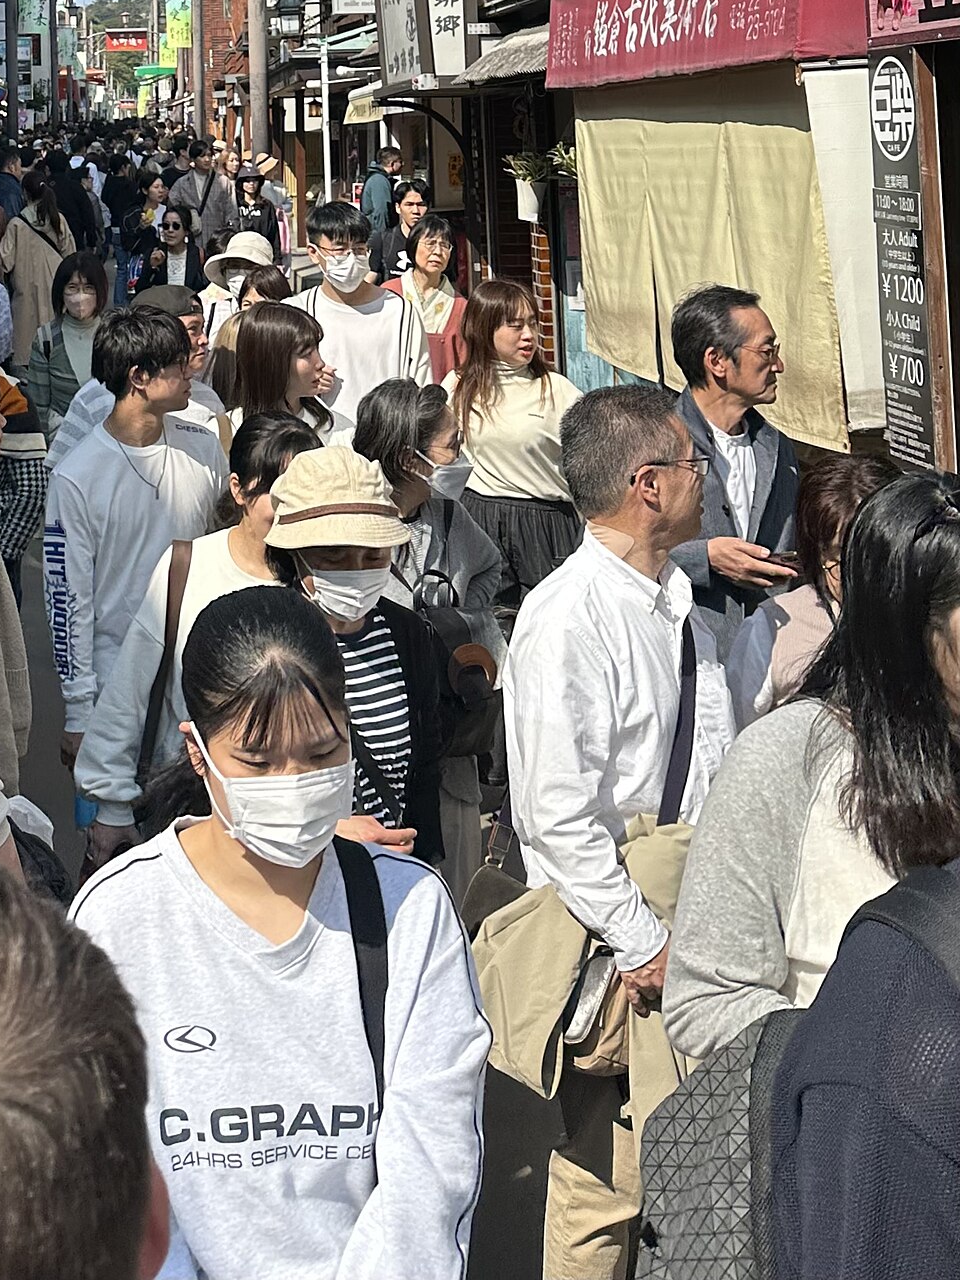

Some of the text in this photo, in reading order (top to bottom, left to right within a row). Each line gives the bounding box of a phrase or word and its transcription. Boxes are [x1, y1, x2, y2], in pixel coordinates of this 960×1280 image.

[872, 74, 912, 141] 豆柴
[887, 143, 901, 152] CAFE
[899, 231, 918, 248] Adult
[902, 312, 920, 331] Child
[888, 352, 923, 386] ¥700
[44, 541, 66, 582] HIT
[52, 591, 70, 676] WONDER
[171, 1150, 242, 1171] 24HRS
[251, 1144, 338, 1167] SERVICE
